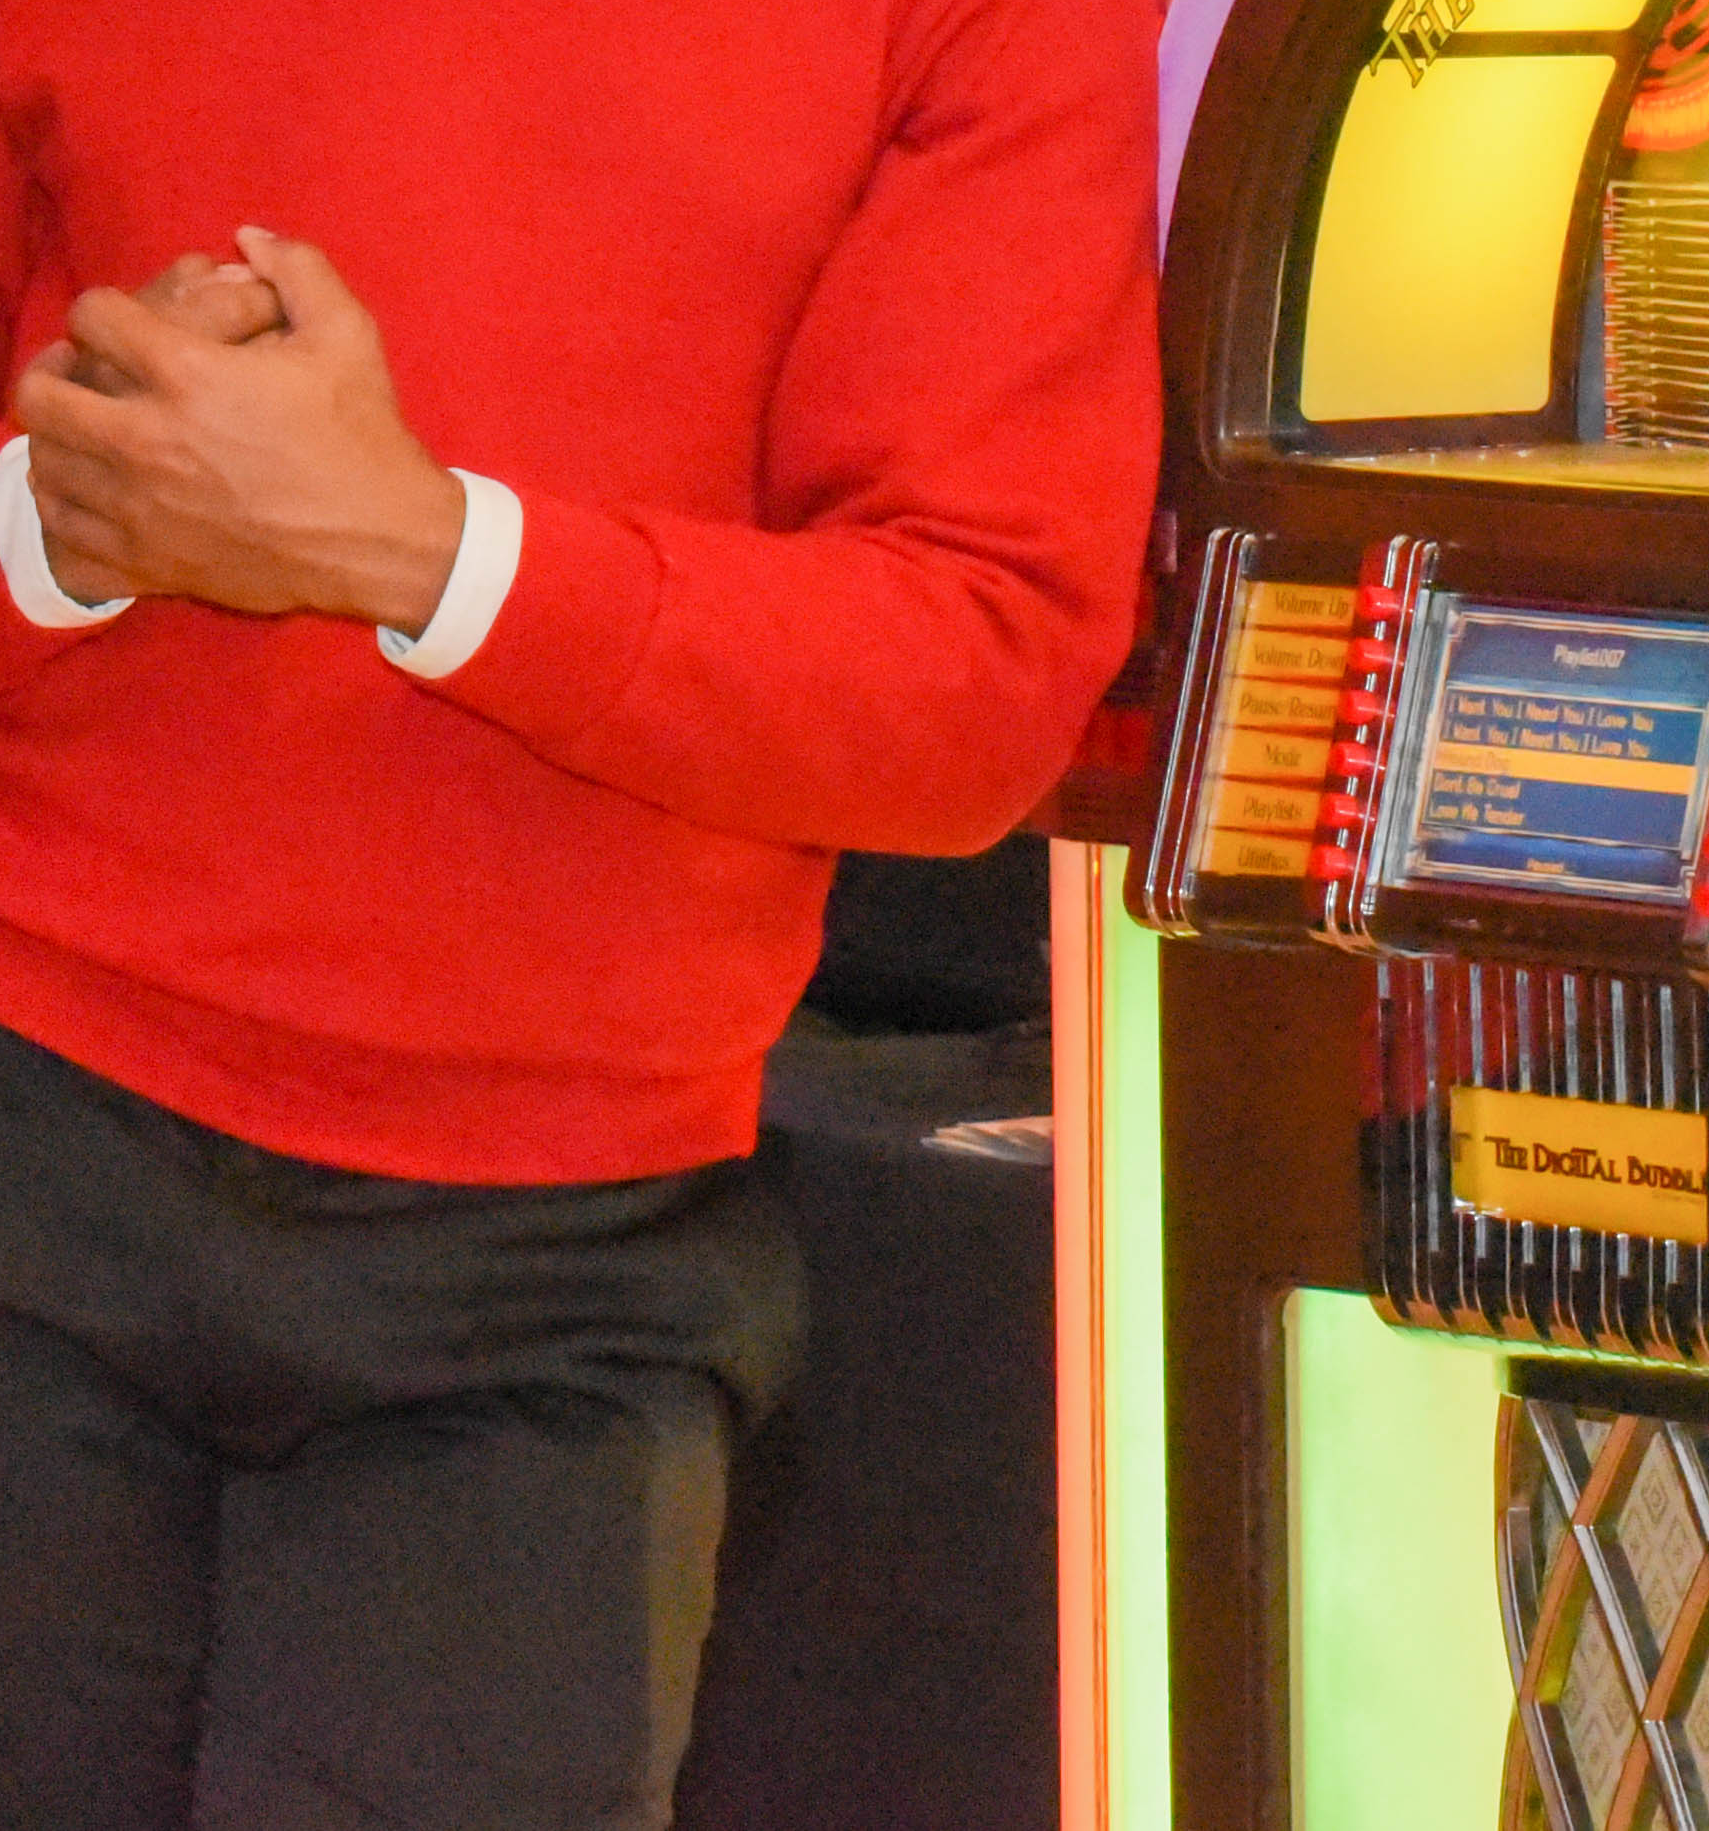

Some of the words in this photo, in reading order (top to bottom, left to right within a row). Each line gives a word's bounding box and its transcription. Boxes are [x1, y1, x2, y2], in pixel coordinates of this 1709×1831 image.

[1275, 590, 1324, 617] Volume
[1328, 592, 1349, 619] Up
[1254, 642, 1302, 667] Volume
[1483, 1135, 1529, 1171] THE
[1532, 1142, 1622, 1184] DIGITAL
